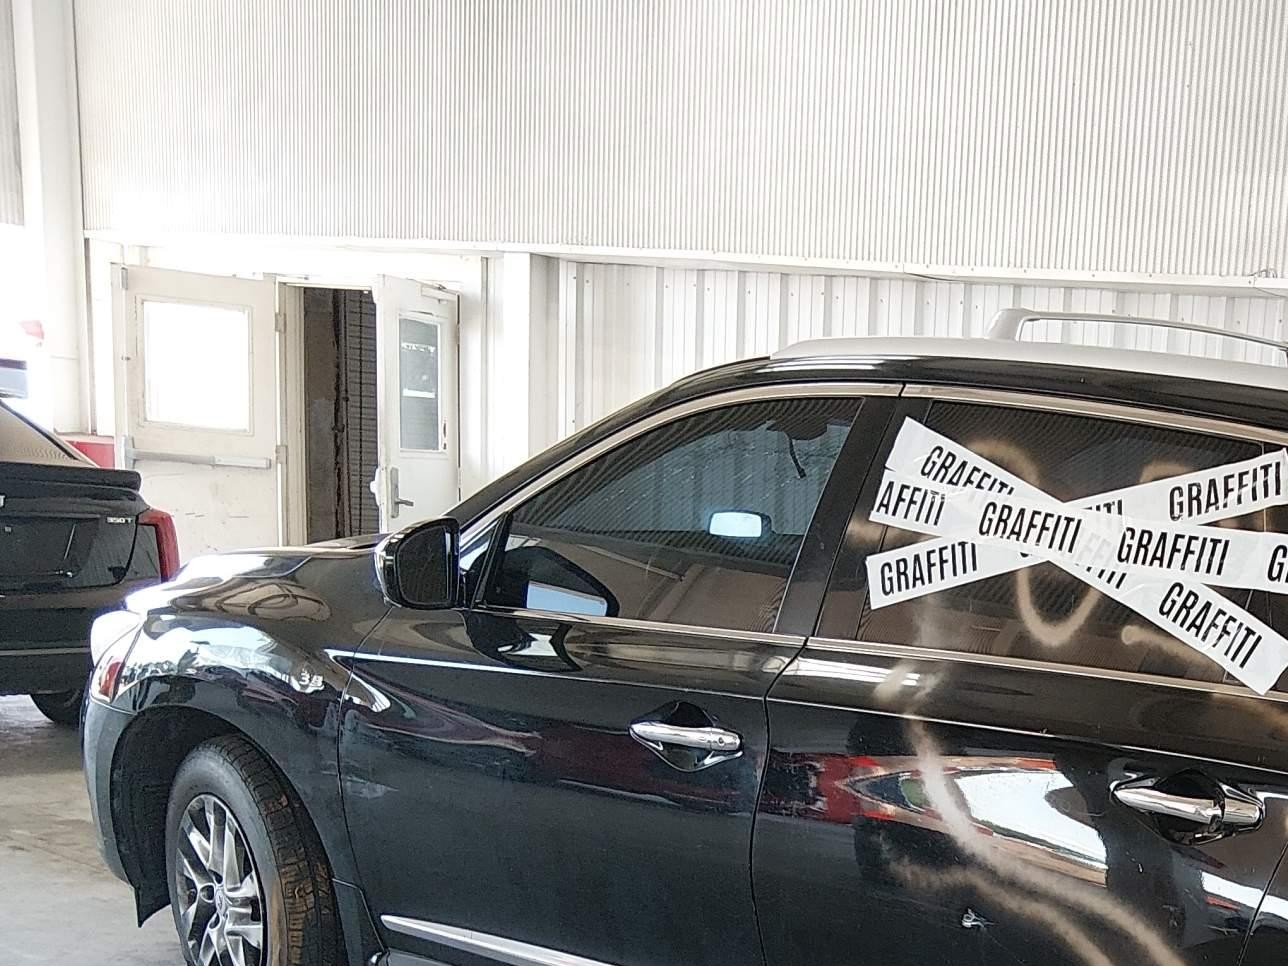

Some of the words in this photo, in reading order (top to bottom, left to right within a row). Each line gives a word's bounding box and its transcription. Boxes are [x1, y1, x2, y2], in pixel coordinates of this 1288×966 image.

[876, 481, 946, 526] AFFITI
[978, 501, 1083, 554] GRAFFITI
[1117, 526, 1230, 576] GRAFFITI
[880, 541, 977, 596] GRAFFITI
[1169, 461, 1281, 522] GRAFFITI
[1158, 582, 1263, 669] GRAFFITI
